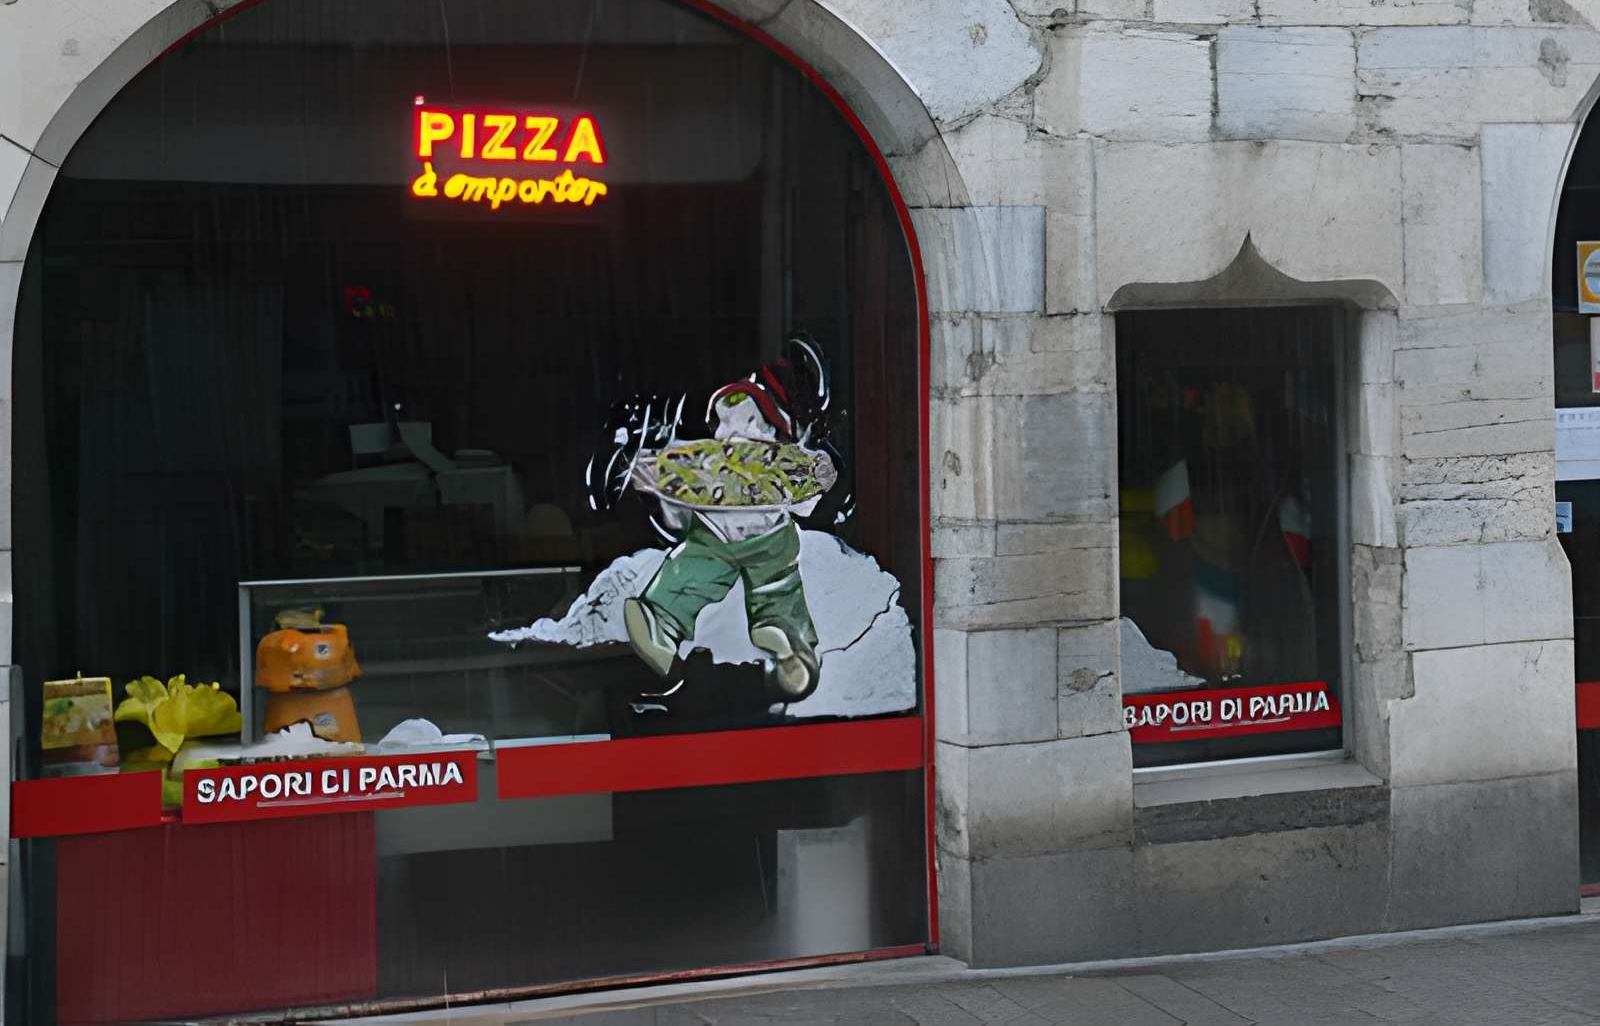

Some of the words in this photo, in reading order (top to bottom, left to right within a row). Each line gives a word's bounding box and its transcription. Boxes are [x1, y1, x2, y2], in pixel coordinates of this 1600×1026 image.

[418, 110, 604, 164] PIZZA
[196, 771, 312, 804] SAPORI
[359, 761, 464, 792] PARMA
